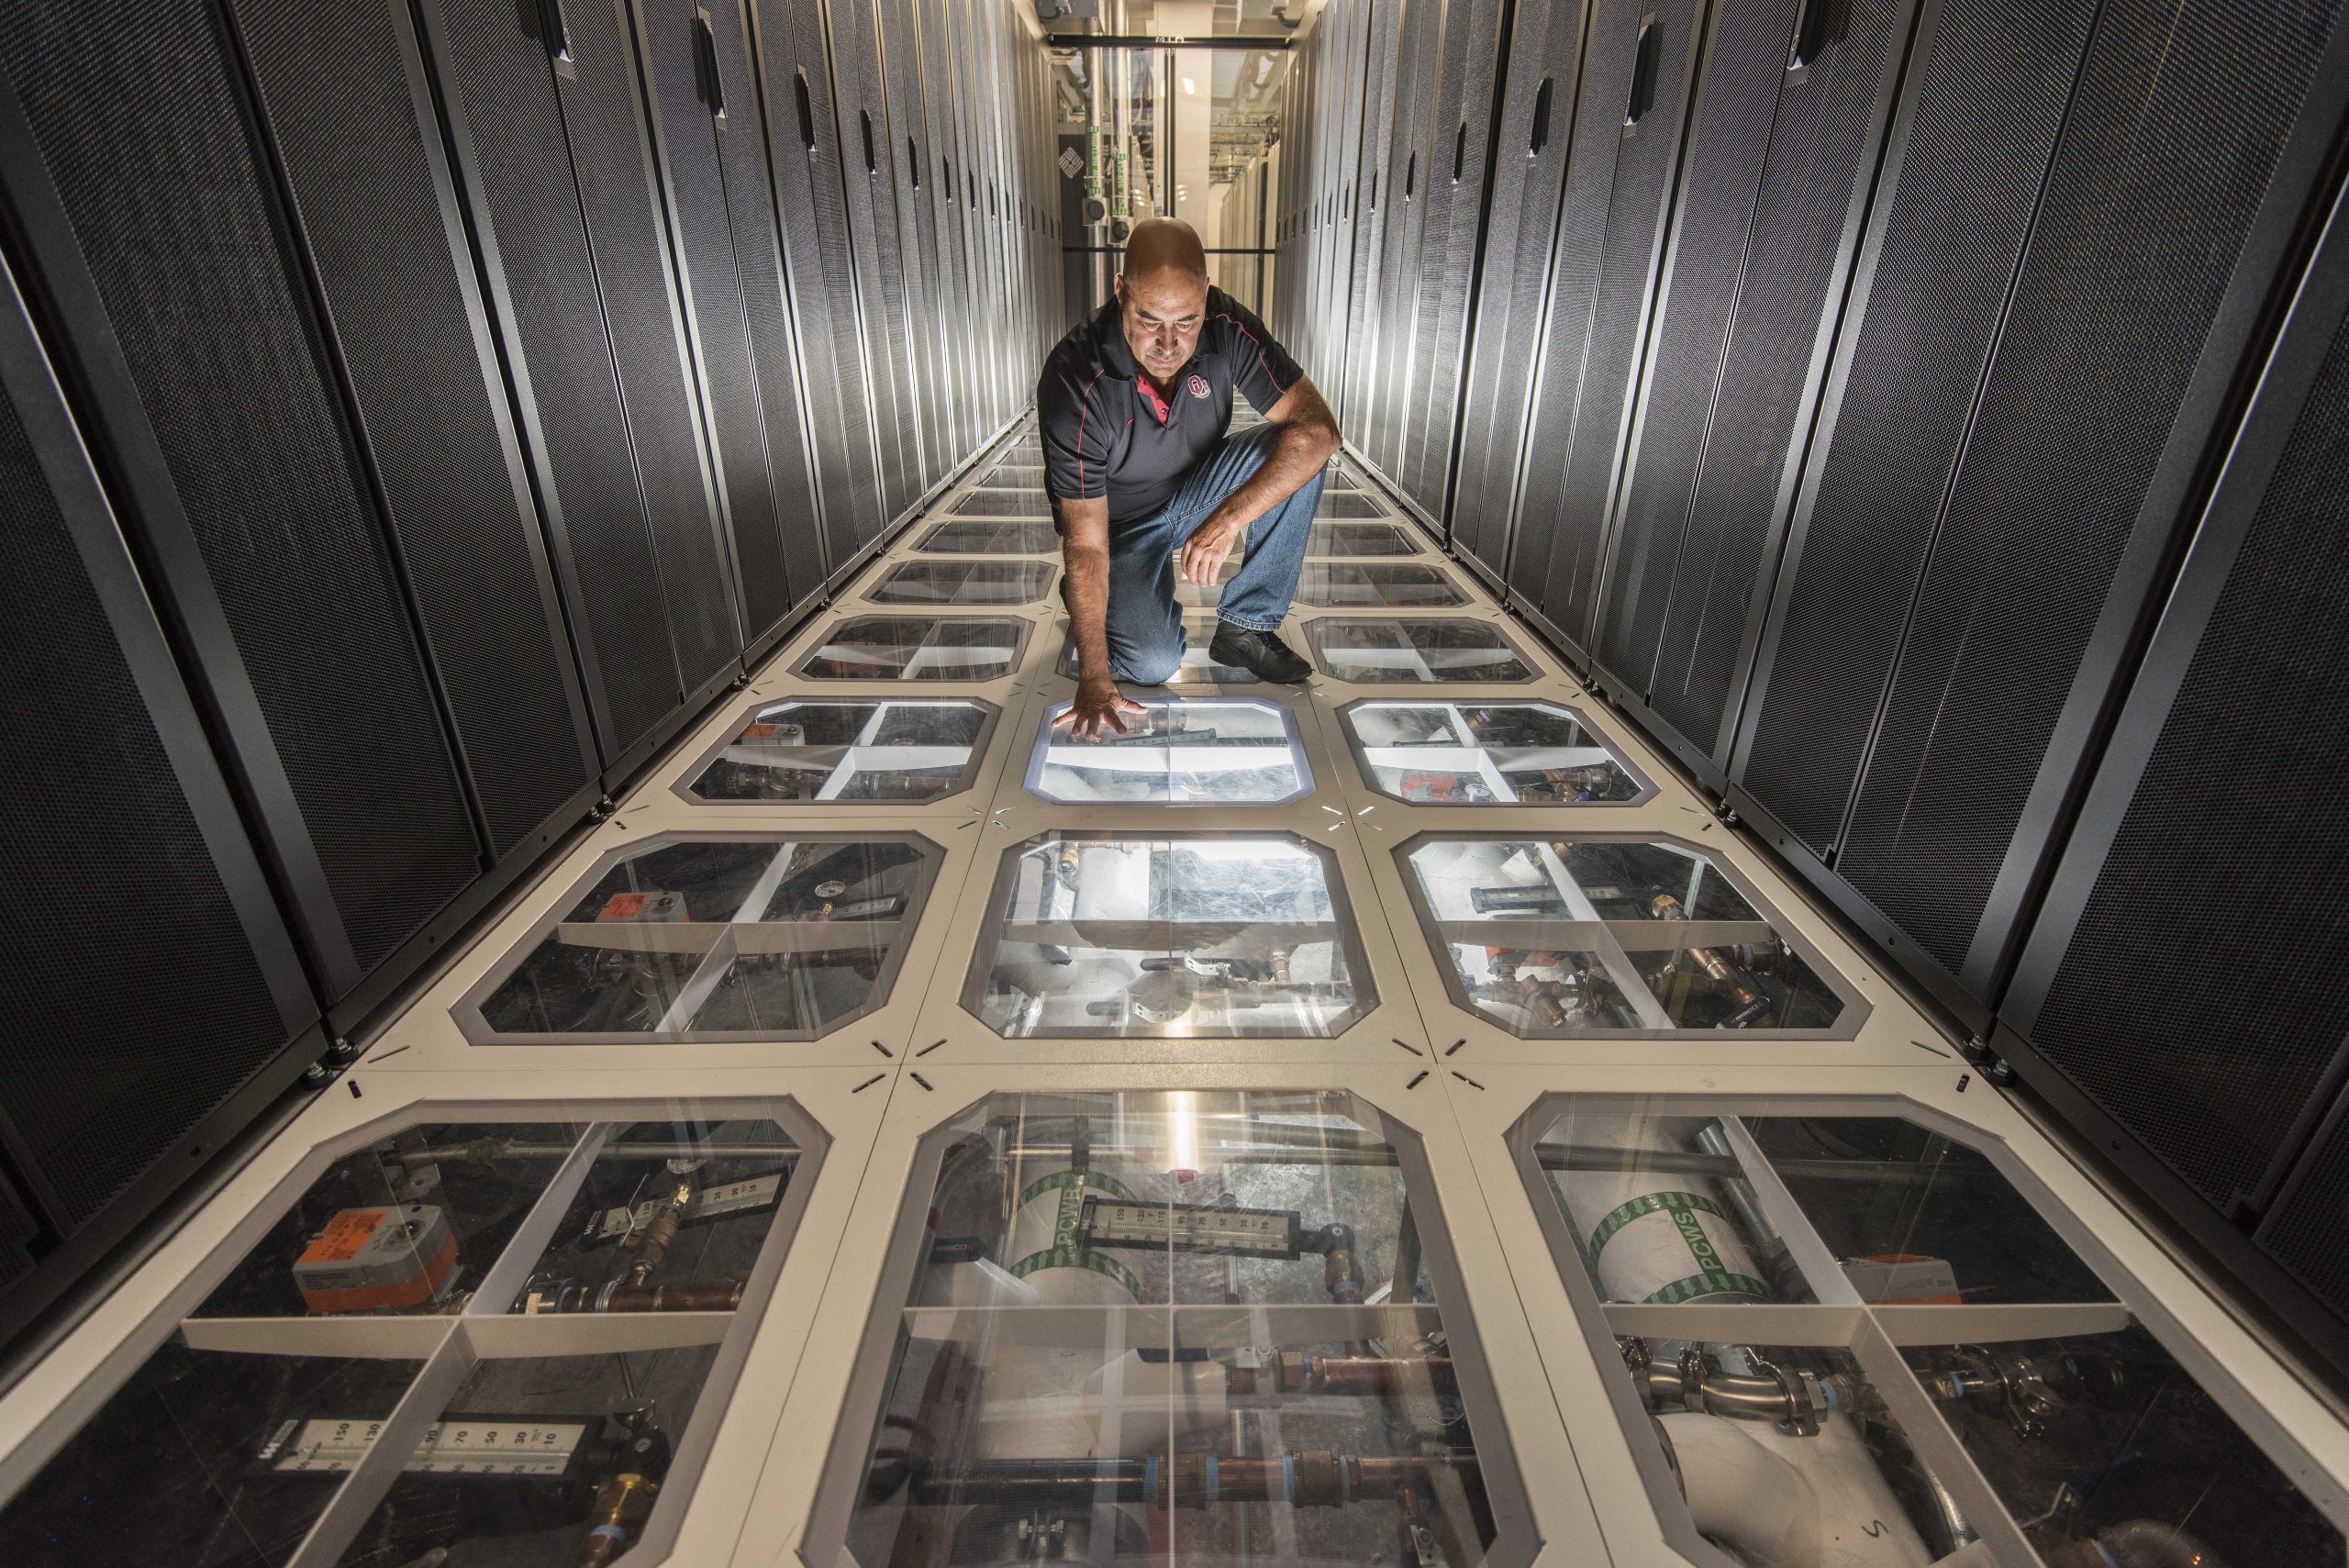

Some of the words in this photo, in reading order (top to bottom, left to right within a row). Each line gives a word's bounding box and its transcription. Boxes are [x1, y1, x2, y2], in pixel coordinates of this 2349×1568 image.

[1091, 169, 1099, 187] PCW
[1056, 1191, 1080, 1245] PCWR
[1117, 1207, 1125, 1220] 150
[1157, 1210, 1165, 1223] 110
[1198, 1217, 1207, 1226] 70
[1219, 1218, 1227, 1227] 50
[1240, 1218, 1248, 1229] 30
[1261, 1221, 1269, 1229] 10
[1675, 1212, 1722, 1270] PCWS
[333, 1423, 351, 1441] 150
[364, 1423, 381, 1441] 130
[426, 1429, 439, 1443] 90
[454, 1430, 468, 1443] 70
[484, 1430, 498, 1444] 50
[514, 1431, 528, 1444] 30
[543, 1433, 557, 1445] 10
